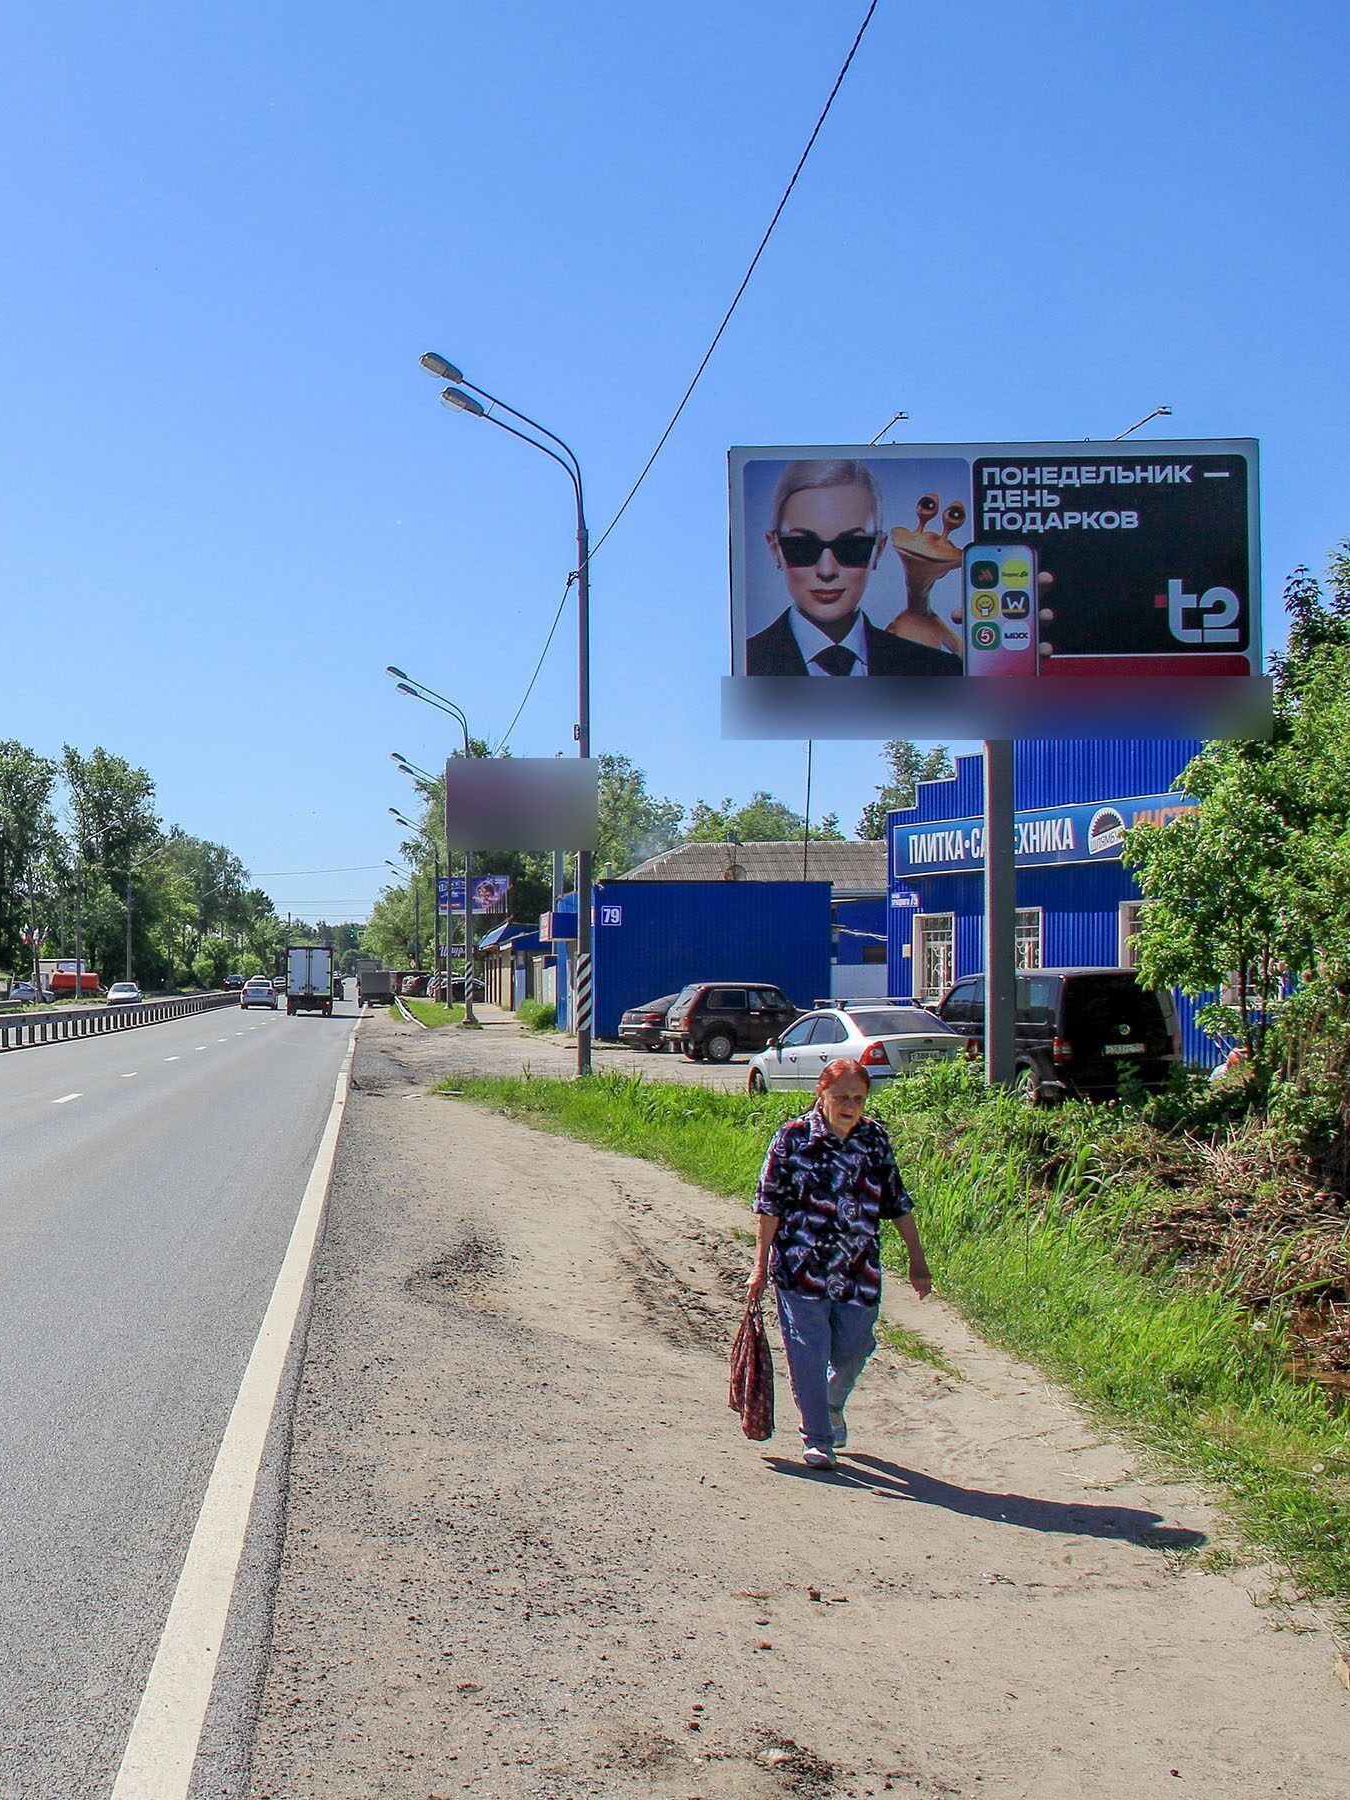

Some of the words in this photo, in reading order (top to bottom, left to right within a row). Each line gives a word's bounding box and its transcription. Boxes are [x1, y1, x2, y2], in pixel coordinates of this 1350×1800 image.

[982, 465, 1193, 488] ПОНЕДЕЛЬНИК
[983, 490, 1061, 511] ДЕНЬ
[983, 511, 1139, 533] ПОДАРКОВ
[1167, 579, 1240, 643] t2
[909, 830, 965, 864] ПЛИТКА
[603, 908, 619, 923] 79
